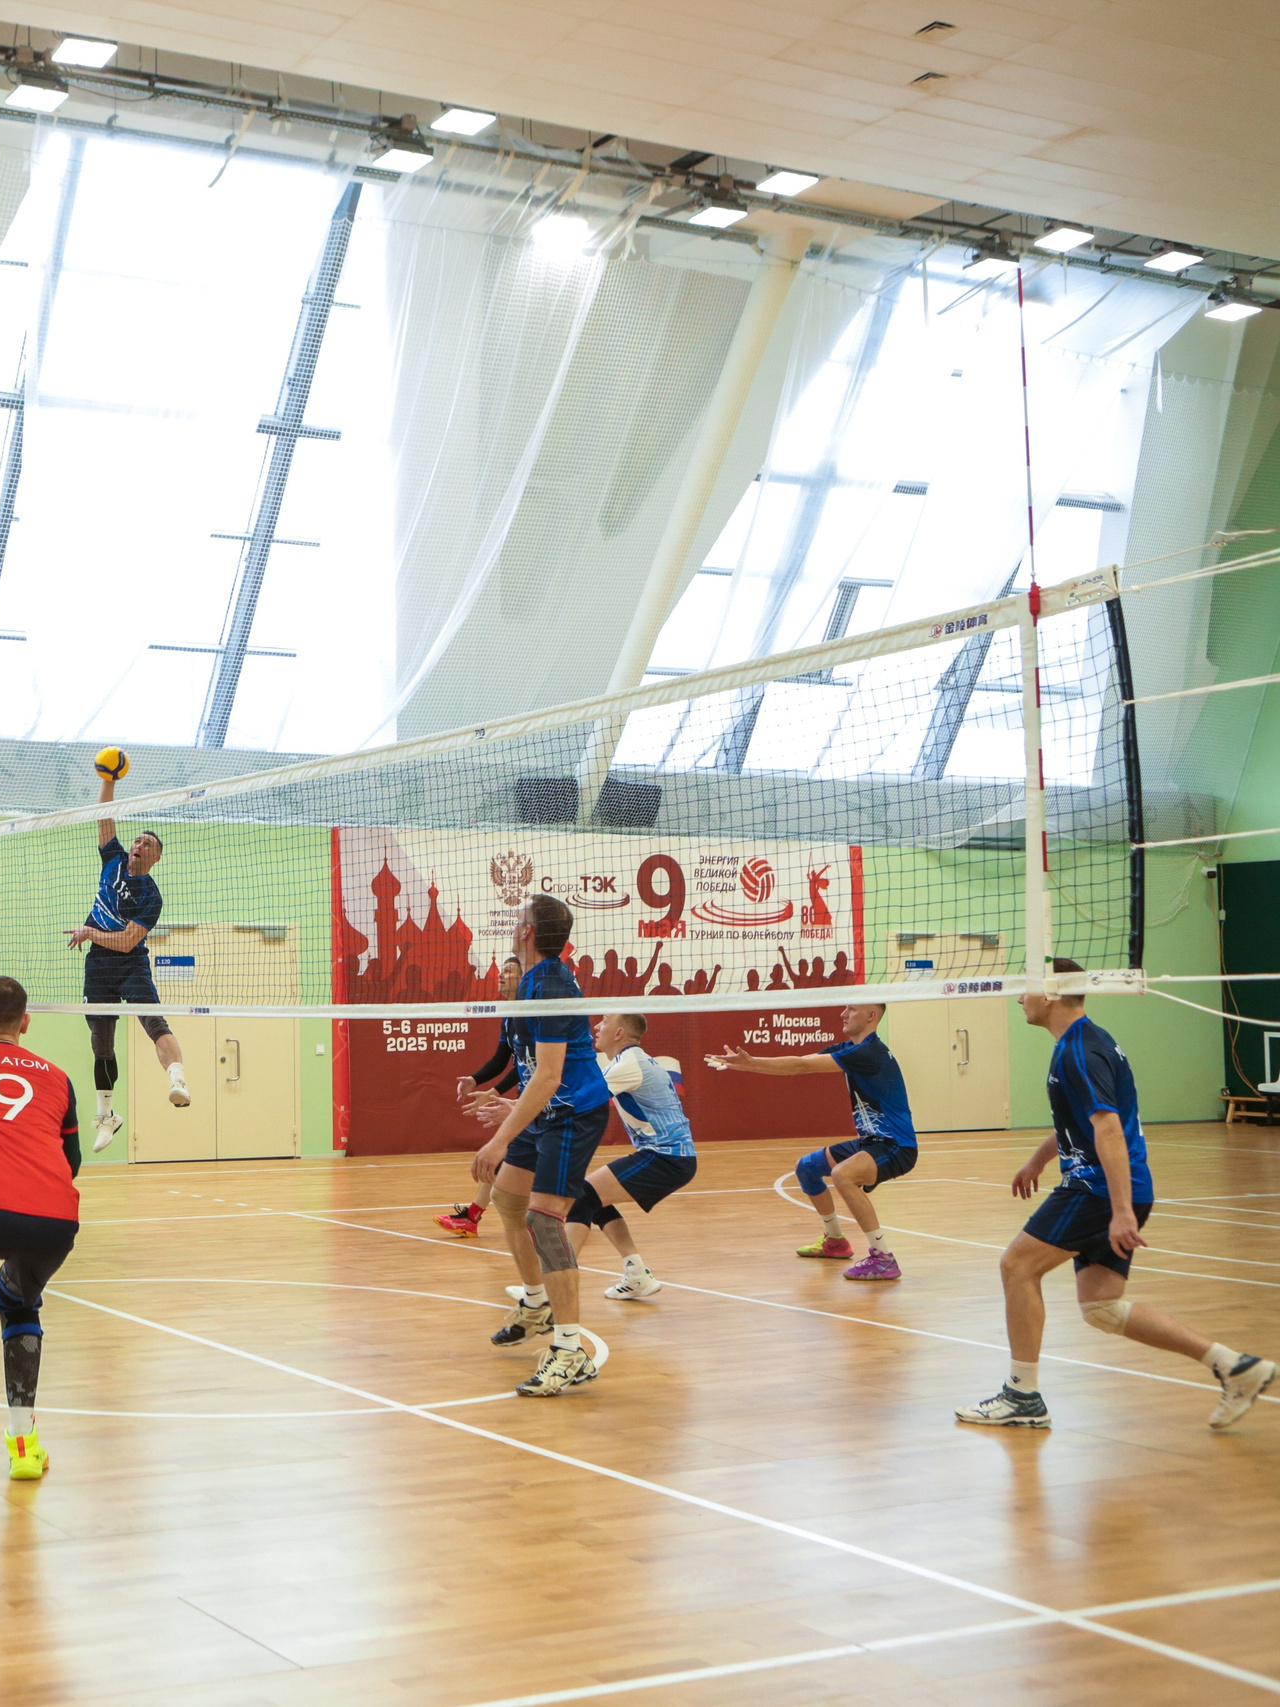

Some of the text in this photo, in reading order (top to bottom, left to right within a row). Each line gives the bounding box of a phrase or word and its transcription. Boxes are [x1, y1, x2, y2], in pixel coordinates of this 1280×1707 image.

[699, 855, 739, 866] ЭНЕРГИЯ
[694, 866, 738, 878] ВЕЛИКОЙ
[637, 854, 686, 928] 9
[696, 881, 737, 893] ПОБЕДЫ
[801, 905, 816, 925] 80
[637, 919, 687, 939] мая
[689, 928, 795, 940] ТУРНИР ПО ВОЛЕЙБОЛУ
[800, 928, 833, 940] ПОБЕДА!
[759, 1014, 821, 1028] г. Москва
[416, 1022, 469, 1037] апреля
[386, 1037, 466, 1052] 2025 года
[743, 1029, 835, 1046] УСЗ «Дружба»
